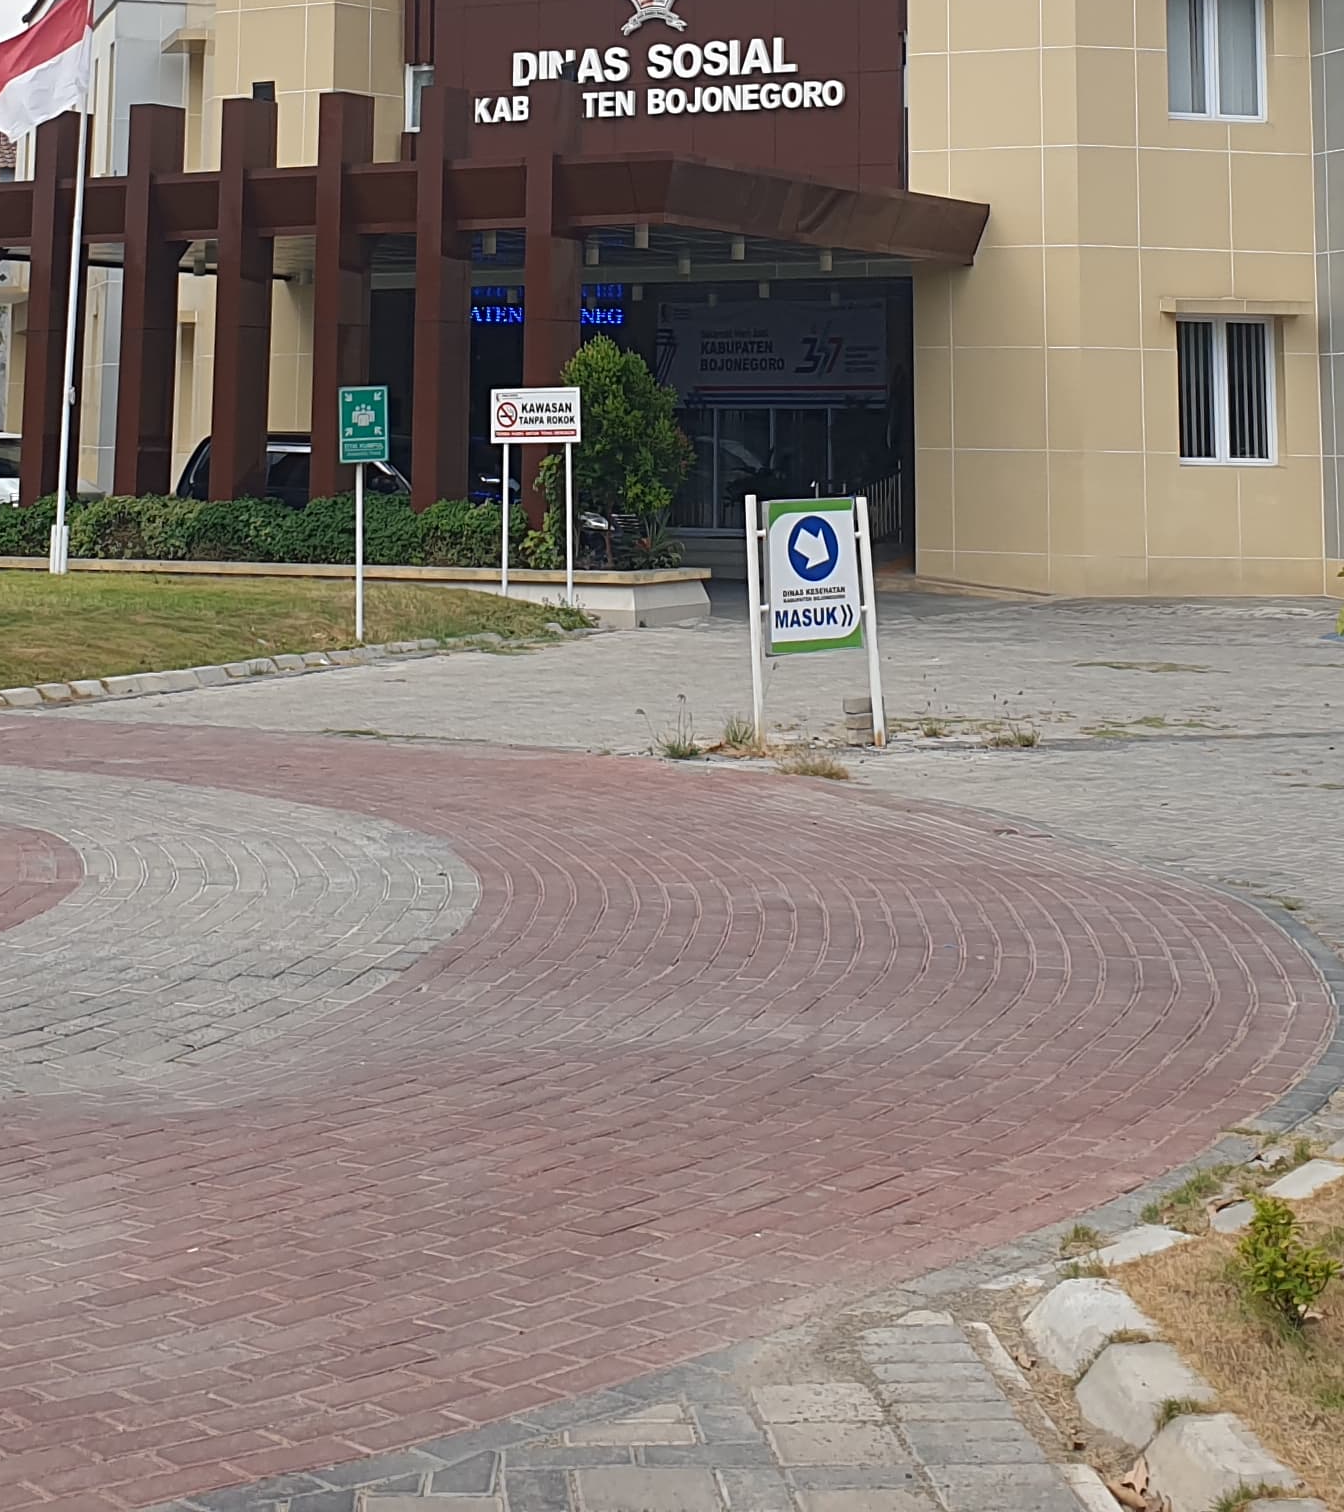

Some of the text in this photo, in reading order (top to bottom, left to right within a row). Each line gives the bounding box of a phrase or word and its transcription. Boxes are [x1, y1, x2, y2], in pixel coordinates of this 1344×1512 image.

[512, 37, 798, 87] DINAS SOSIAL
[474, 80, 846, 123] KABTEN BOJONEGORO
[701, 340, 773, 355] KABUPATEN
[700, 357, 785, 372] BOJONEGORO
[521, 402, 572, 414] KAWASAN
[519, 415, 576, 425] TANPA ROKOK
[775, 606, 838, 629] MASUK
